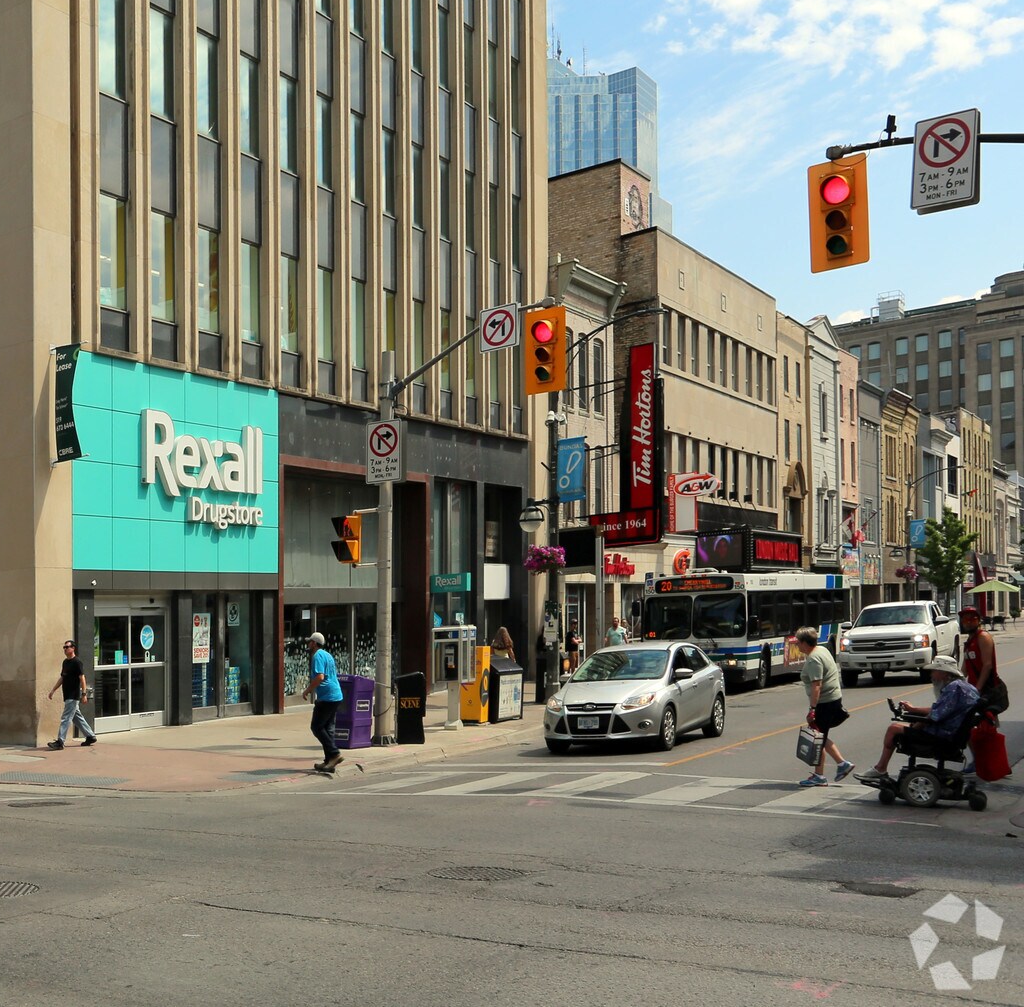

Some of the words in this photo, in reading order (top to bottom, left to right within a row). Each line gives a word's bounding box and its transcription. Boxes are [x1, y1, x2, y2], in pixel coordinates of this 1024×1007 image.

[927, 173, 939, 181] AM
[956, 167, 968, 175] AM
[928, 184, 939, 192] PM
[946, 189, 957, 197] FRI
[632, 368, 652, 446] Hortons
[58, 447, 74, 456] CBRE
[141, 409, 263, 496] Rexall
[632, 448, 652, 487] Tim
[681, 480, 714, 493] A&W
[188, 496, 263, 529] Drugstore
[603, 522, 622, 531] ince
[625, 518, 647, 529] 1964
[436, 575, 461, 588] Rexall
[661, 581, 672, 591] 20
[400, 699, 420, 708] SCENE
